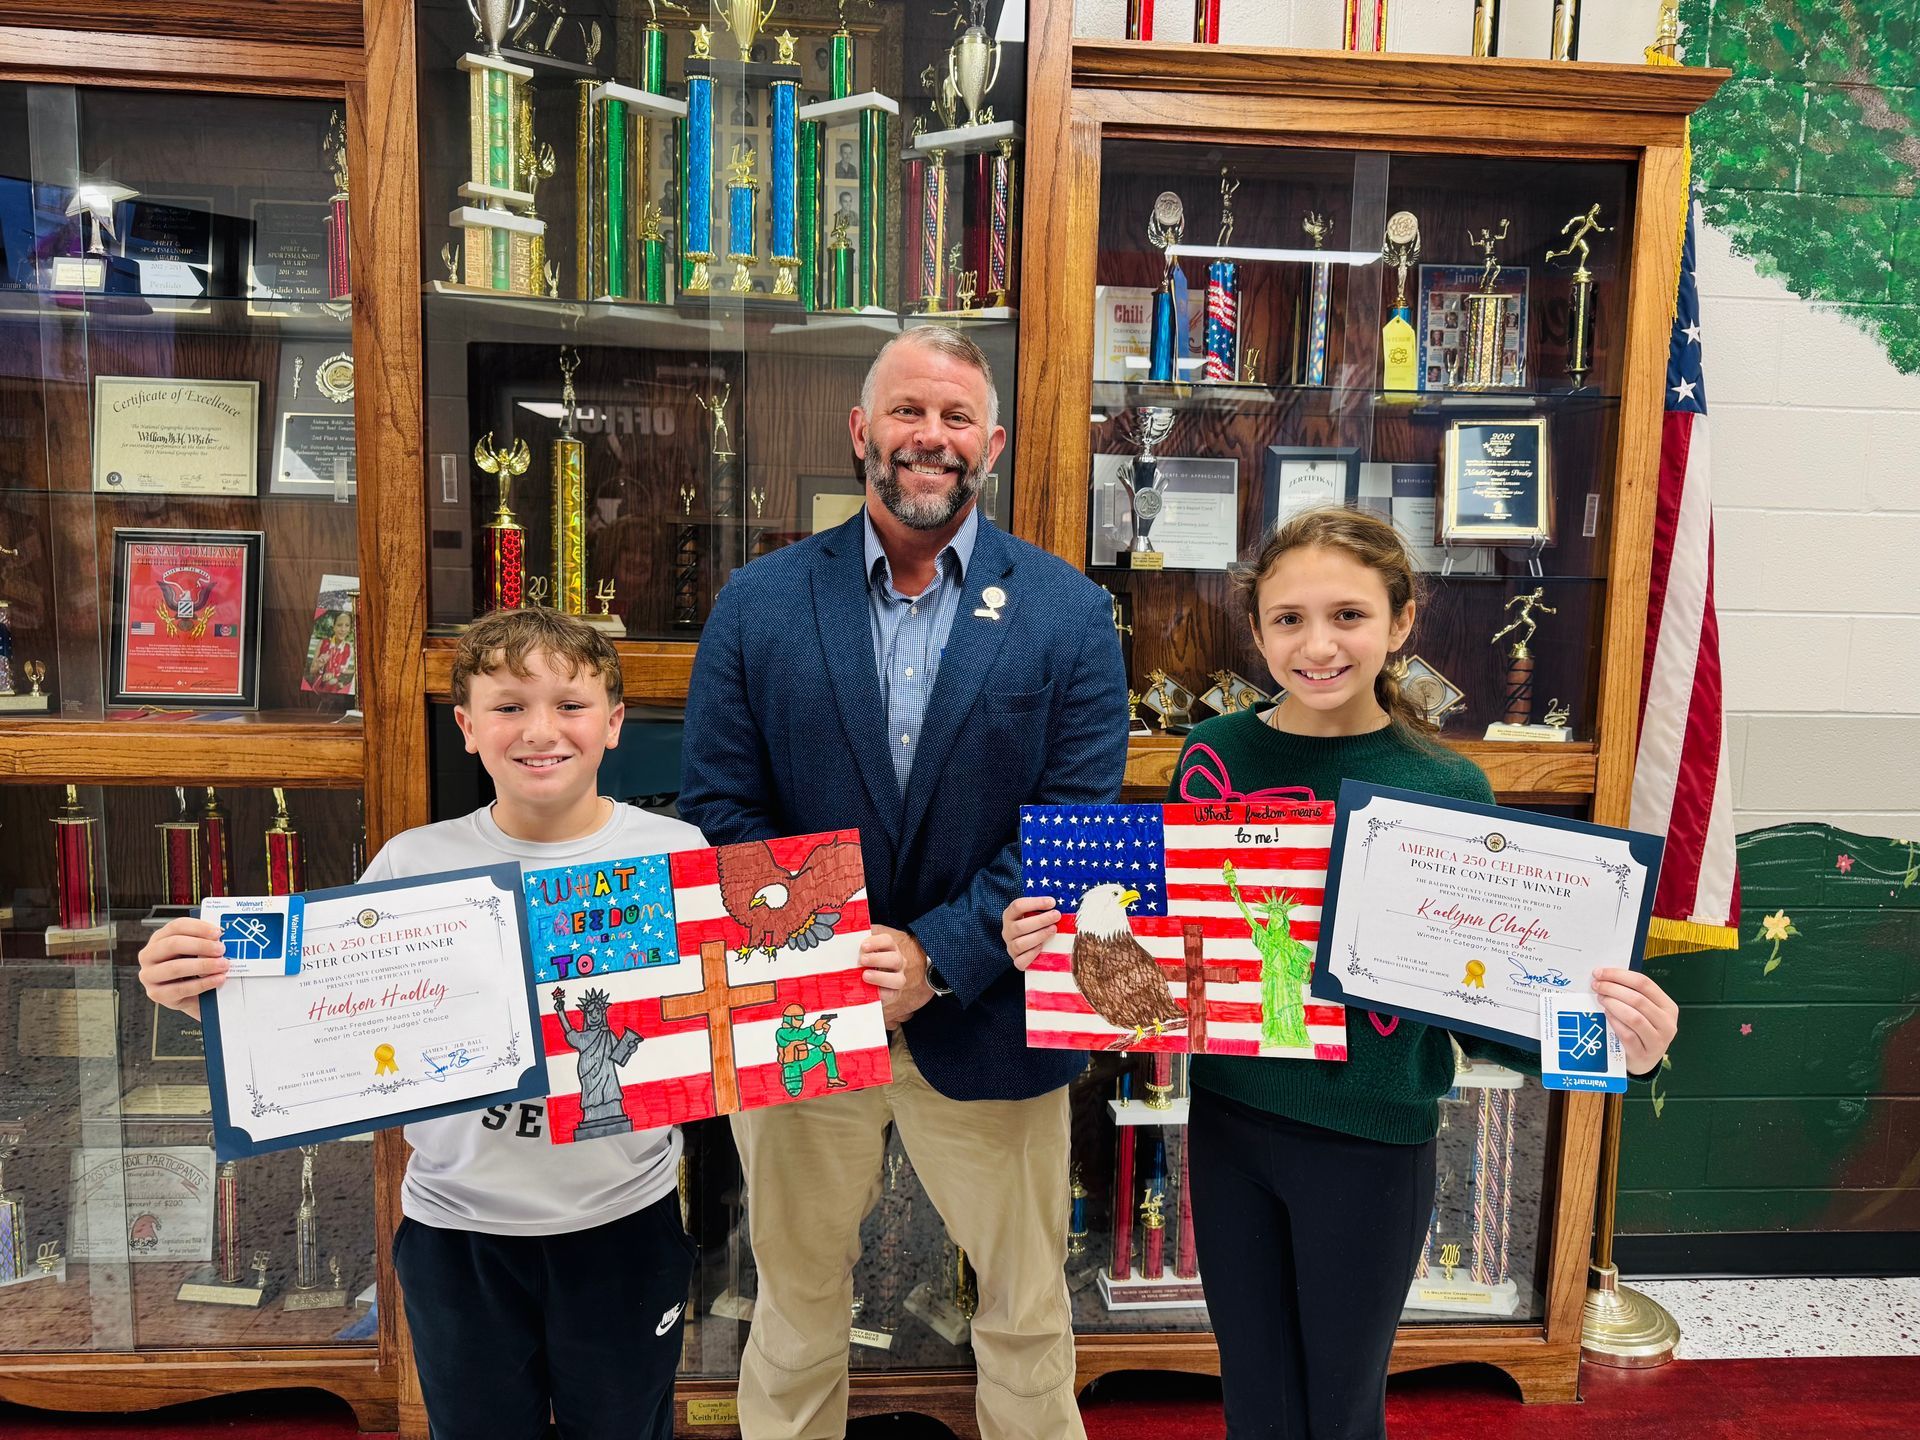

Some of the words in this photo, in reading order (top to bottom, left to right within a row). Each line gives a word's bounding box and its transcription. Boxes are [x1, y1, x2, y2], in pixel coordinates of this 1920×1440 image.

[296, 286, 321, 295] Middle
[1114, 304, 1144, 324] Chili
[112, 388, 168, 414] Certificate
[171, 388, 184, 404] of
[185, 390, 241, 418] Excellence
[134, 545, 180, 556] SIGNAL
[181, 546, 240, 559] COMPANY
[595, 578, 616, 600] 14
[1548, 698, 1570, 716] 2nd
[1194, 806, 1233, 822] What
[1235, 827, 1250, 844] to
[1254, 827, 1279, 844] me!
[1398, 842, 1458, 862] AMERICA
[1462, 854, 1488, 868] 250
[1491, 860, 1590, 888] CELEBRATION
[538, 866, 636, 906] WHAT
[1410, 858, 1456, 876] POSTER
[1461, 868, 1519, 888] CONTEST
[1522, 880, 1572, 898] WINNER
[1429, 880, 1456, 890] BALDWIN
[1457, 885, 1482, 894] COUNTY
[1483, 891, 1520, 902] COMMISSION
[1531, 900, 1550, 908] PROUD
[1440, 889, 1464, 898] PRESENT
[1482, 898, 1522, 909] CERTIFICATE
[290, 914, 300, 946] Walmart
[1416, 898, 1486, 930] Kaelynn
[1488, 912, 1551, 946] Chafin
[302, 942, 336, 957] RICA
[340, 937, 365, 950] 250
[370, 920, 468, 944] CELEBRATION
[1416, 931, 1442, 941] Winner
[1491, 946, 1509, 956] Most
[1511, 951, 1544, 962] Creative
[1450, 930, 1484, 942] Freedom
[1486, 938, 1509, 948] Means
[302, 957, 338, 972] OSTER
[342, 946, 400, 964] CONTEST
[406, 937, 454, 952] WINNER
[314, 976, 342, 985] BALDWIN
[344, 971, 369, 980] COUNTY
[370, 964, 408, 974] COMMISSION
[418, 958, 438, 966] PROUD
[551, 954, 594, 979] TO
[326, 981, 353, 990] PRESENT
[372, 970, 410, 982] CERTIFICATE
[308, 992, 378, 1021] Hudson
[381, 978, 450, 1007] Hadley
[314, 1034, 341, 1044] Winner
[423, 1014, 450, 1024] Choice
[350, 1018, 384, 1030] Freedom
[386, 1013, 410, 1022] Means
[412, 1010, 422, 1018] to
[302, 1076, 338, 1086] ELEMENTARY
[340, 1071, 361, 1079] SCHOOL
[316, 1068, 336, 1076] GRADE
[1574, 1079, 1608, 1088] Walmart
[110, 1156, 144, 1174] SCHOOL
[146, 1155, 204, 1186] PARTICIPANTS
[128, 1200, 152, 1208] amount
[1140, 1188, 1164, 1209] 1st
[37, 1240, 60, 1259] 07
[1440, 1244, 1461, 1265] 2016
[661, 1302, 680, 1326] NIKE
